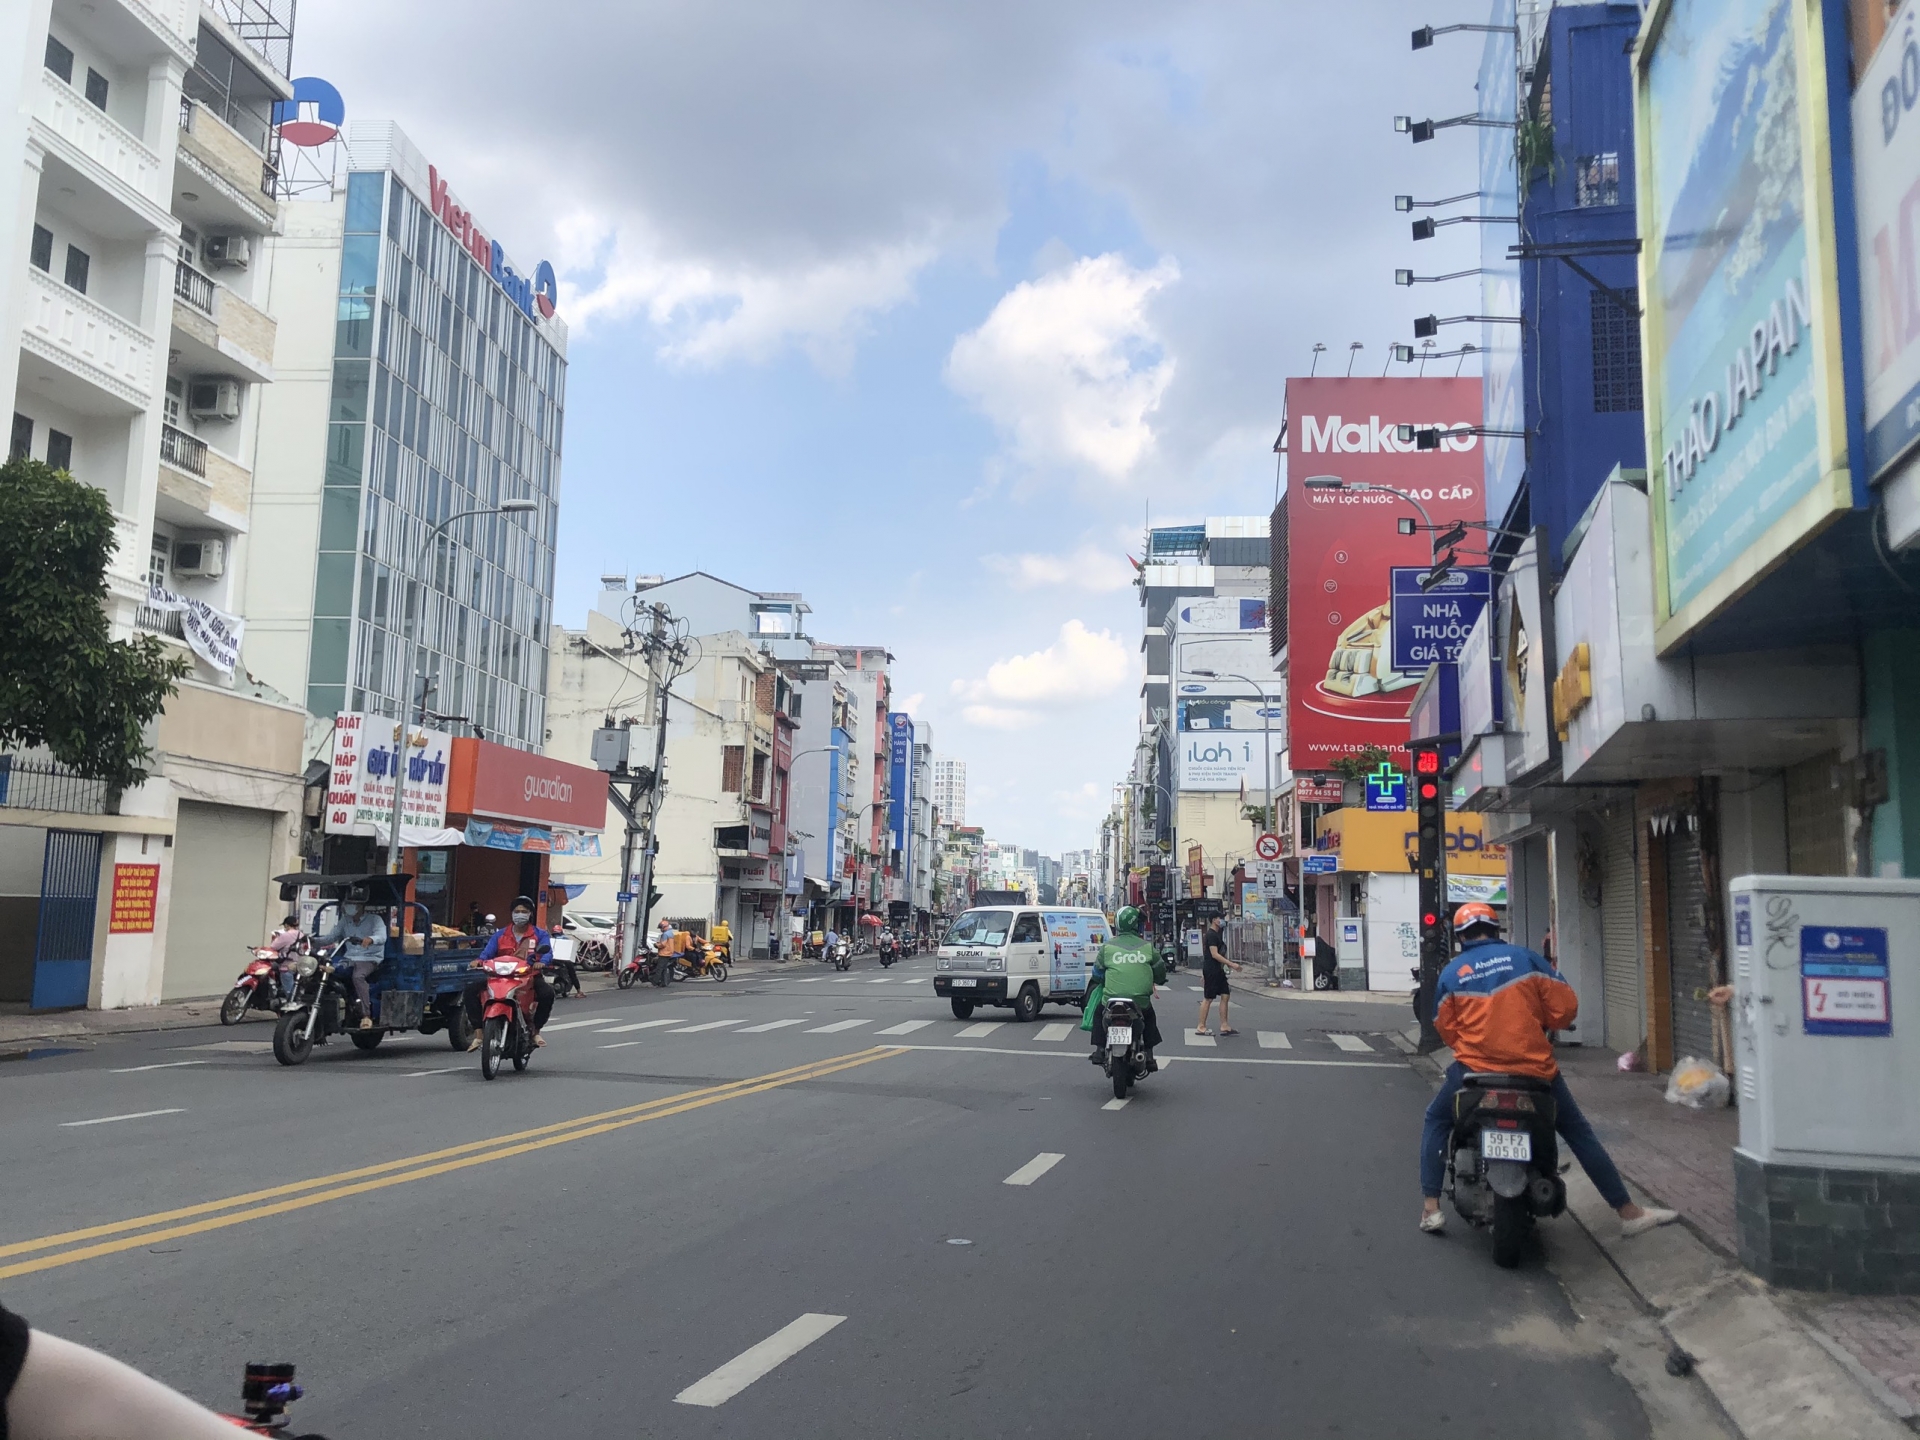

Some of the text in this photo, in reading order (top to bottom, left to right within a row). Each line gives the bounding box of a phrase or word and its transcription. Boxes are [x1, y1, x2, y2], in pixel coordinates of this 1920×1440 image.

[429, 164, 536, 321] VietinBank
[1662, 391, 1722, 502] THẢO
[1724, 258, 1811, 432] JAPAN
[1313, 493, 1394, 506] MÁY LỌC NƯỚC
[1397, 484, 1474, 500] CAO CẤP
[1423, 600, 1462, 618] NHÀ
[1412, 618, 1472, 639] THUỐC
[1410, 640, 1465, 661] GIÁ TỐ
[336, 715, 361, 732] GIẶT
[342, 732, 353, 748] ỦI
[335, 751, 357, 767] HẤP
[409, 750, 429, 782] HẤP
[428, 750, 446, 786] TẨY
[524, 773, 573, 804] guardian
[328, 789, 357, 805] QUẦN
[332, 808, 347, 824] ÁO
[742, 867, 765, 876] Tuấn
[1112, 951, 1147, 964] Grab
[1475, 955, 1512, 970] AhaMove
[1490, 1133, 1524, 1146] 59-F2
[1487, 1145, 1528, 1160] 305.80
